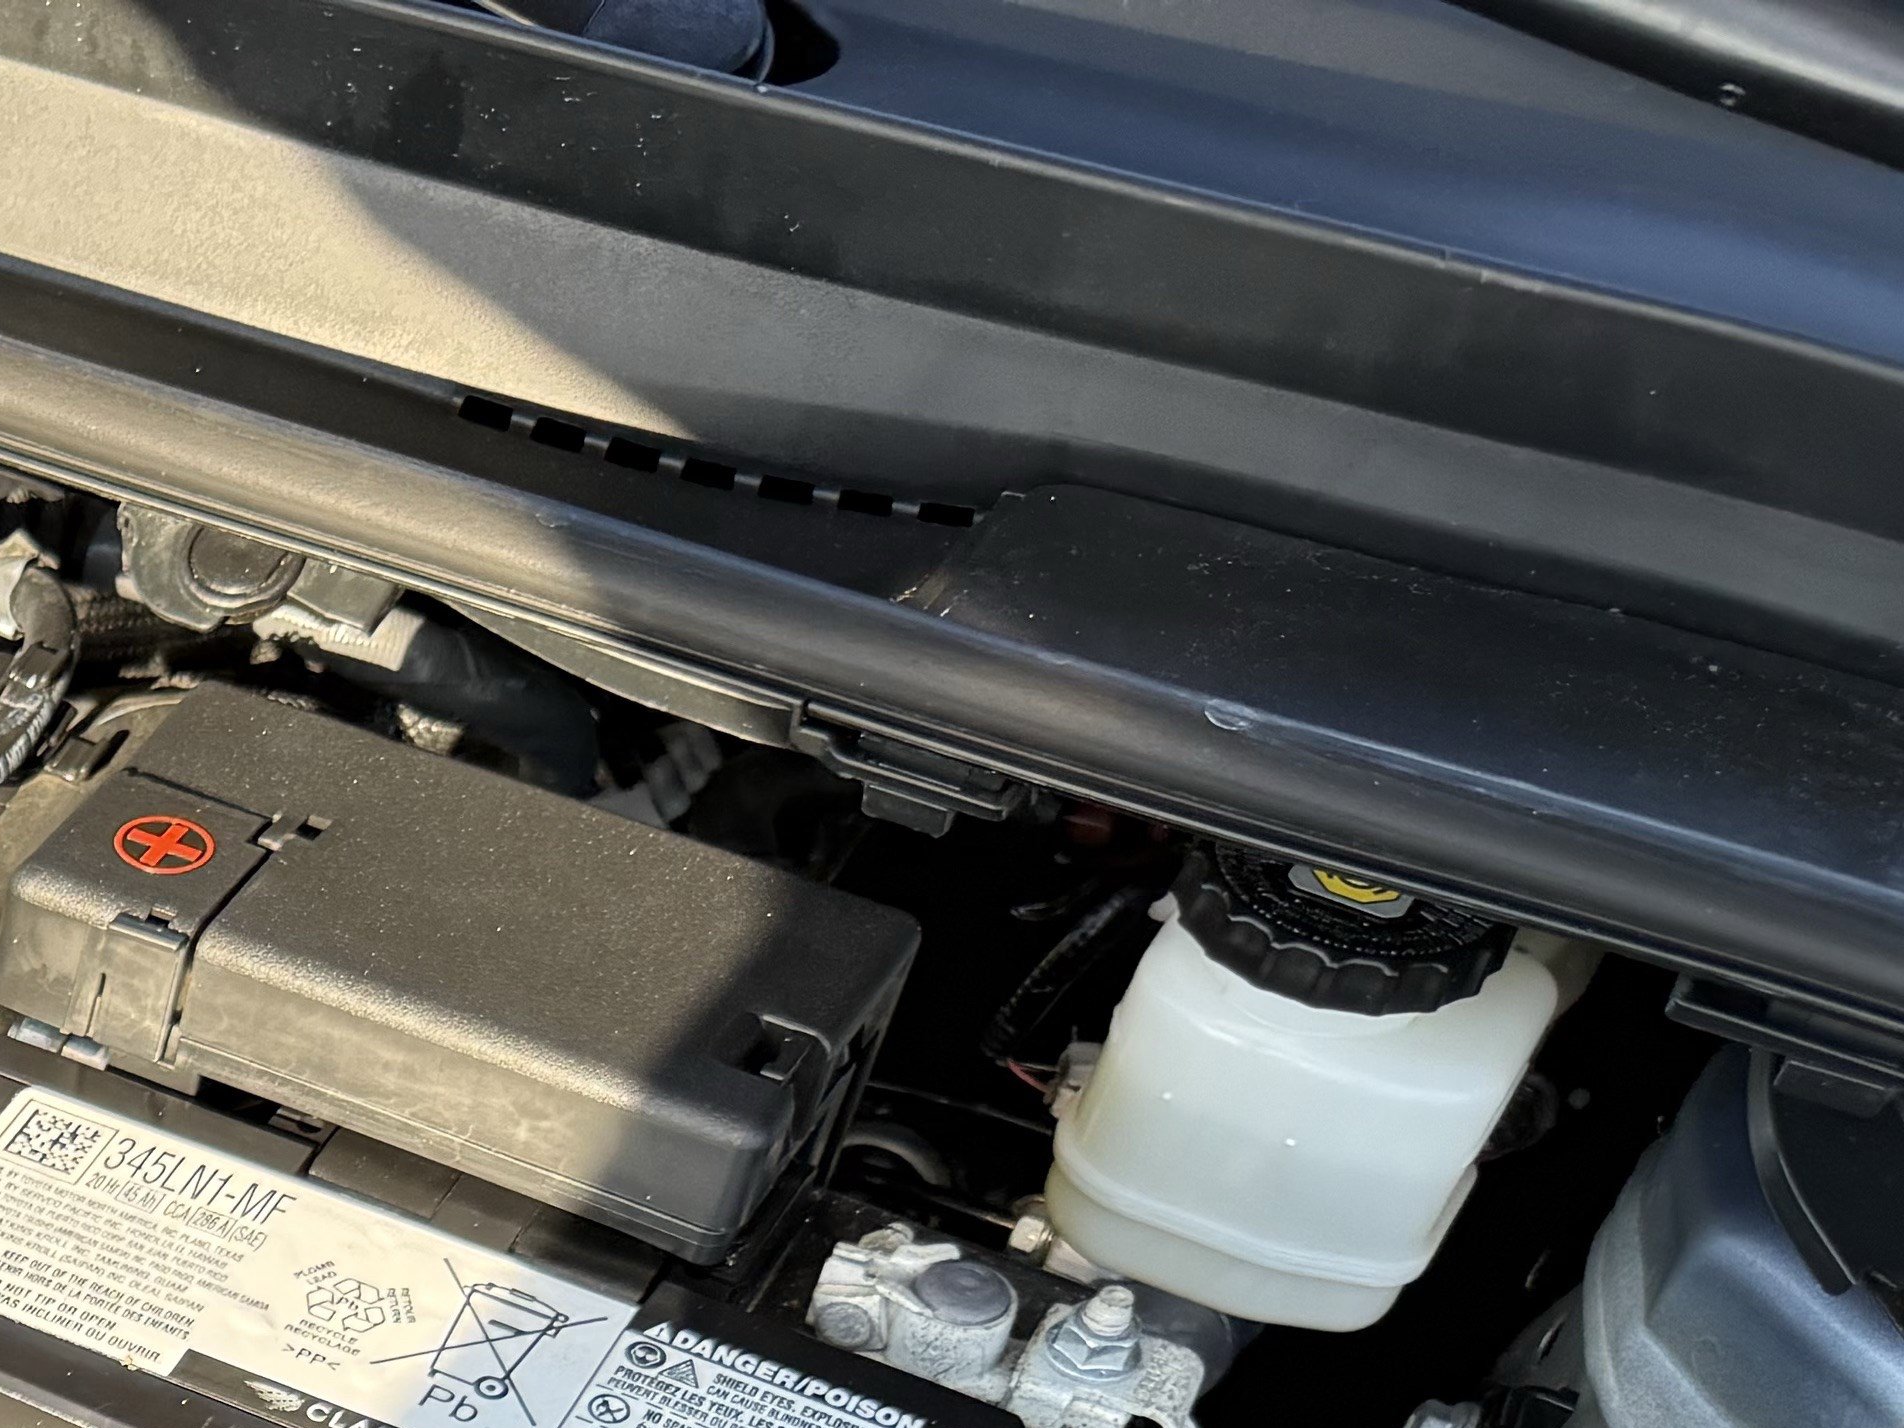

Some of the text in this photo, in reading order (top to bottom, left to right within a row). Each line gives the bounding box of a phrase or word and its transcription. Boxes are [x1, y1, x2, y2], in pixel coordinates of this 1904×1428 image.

[101, 1135, 296, 1228] 345LN1-MF
[84, 1172, 107, 1190] 20
[120, 1185, 141, 1202] 45
[162, 1200, 193, 1221] CCA
[229, 1223, 269, 1248] (SAE)
[0, 1249, 28, 1265] KEEP
[28, 1259, 51, 1273] OUT
[50, 1268, 67, 1279] OF
[66, 1274, 87, 1287] THE
[124, 1296, 140, 1307] OF
[306, 1270, 337, 1285] LEAD
[3, 1282, 31, 1298] NOT
[33, 1293, 56, 1308] TIP
[56, 1302, 78, 1316] OR
[84, 1327, 106, 1341] OU
[283, 1323, 360, 1356] RECYCLAGE
[298, 1319, 358, 1345] RECYCLE
[679, 1391, 706, 1407] LES
[704, 1385, 729, 1400] CAN
[729, 1394, 767, 1415] CAUSE
[712, 1373, 760, 1398] SHIELD
[416, 1383, 487, 1425] Pb
[605, 1376, 658, 1402] PEUVENT
[657, 1396, 709, 1422] BLESSER
[709, 1416, 728, 1428] OU
[641, 1409, 663, 1424] NO
